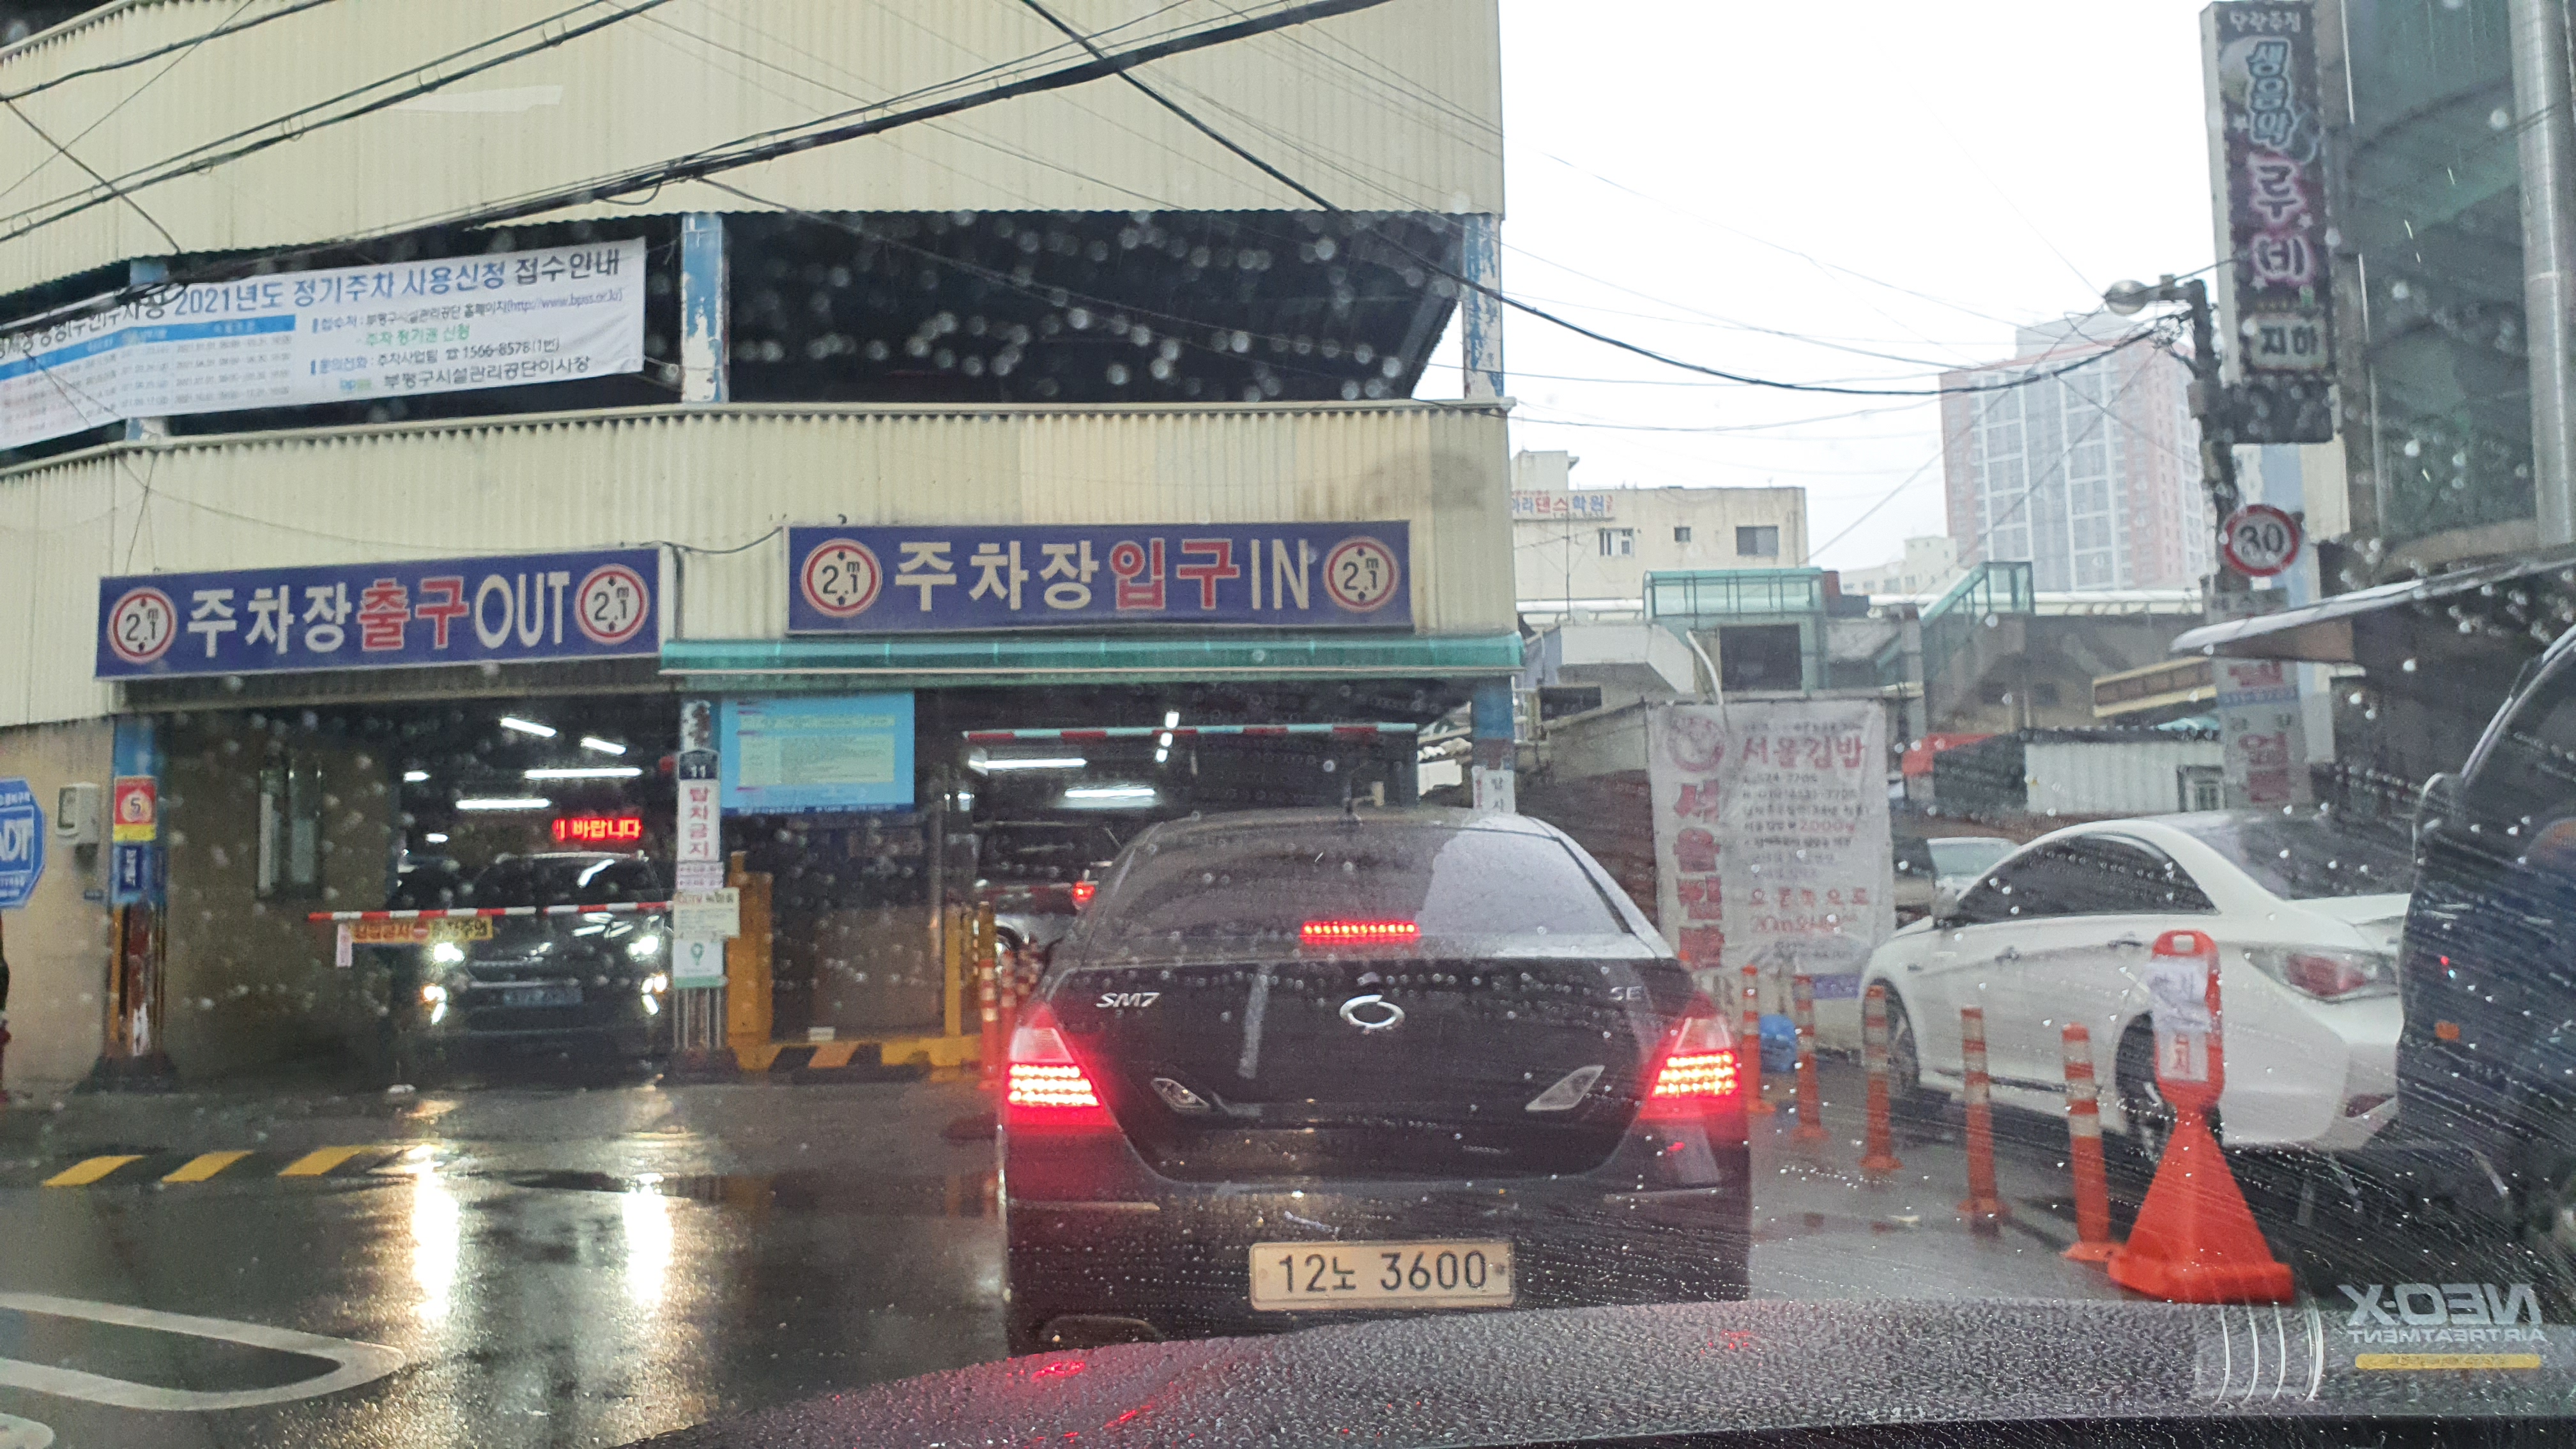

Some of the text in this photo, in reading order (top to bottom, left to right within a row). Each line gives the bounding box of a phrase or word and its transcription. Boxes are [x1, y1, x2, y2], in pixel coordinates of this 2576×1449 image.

[175, 282, 283, 316] 2021년도
[294, 271, 394, 307] 정기주차
[402, 261, 505, 296] 사용신청
[515, 249, 620, 285] 접수안내
[385, 356, 591, 388] 부평구시설관리공단이사장
[2239, 523, 2285, 557] 30
[1250, 537, 1310, 610] IN
[475, 570, 571, 650] OUT
[0, 818, 34, 861] DT
[572, 818, 642, 840] 바랍니다
[1096, 992, 1160, 1008] SM7
[1278, 1250, 1489, 1294] 12노 3600
